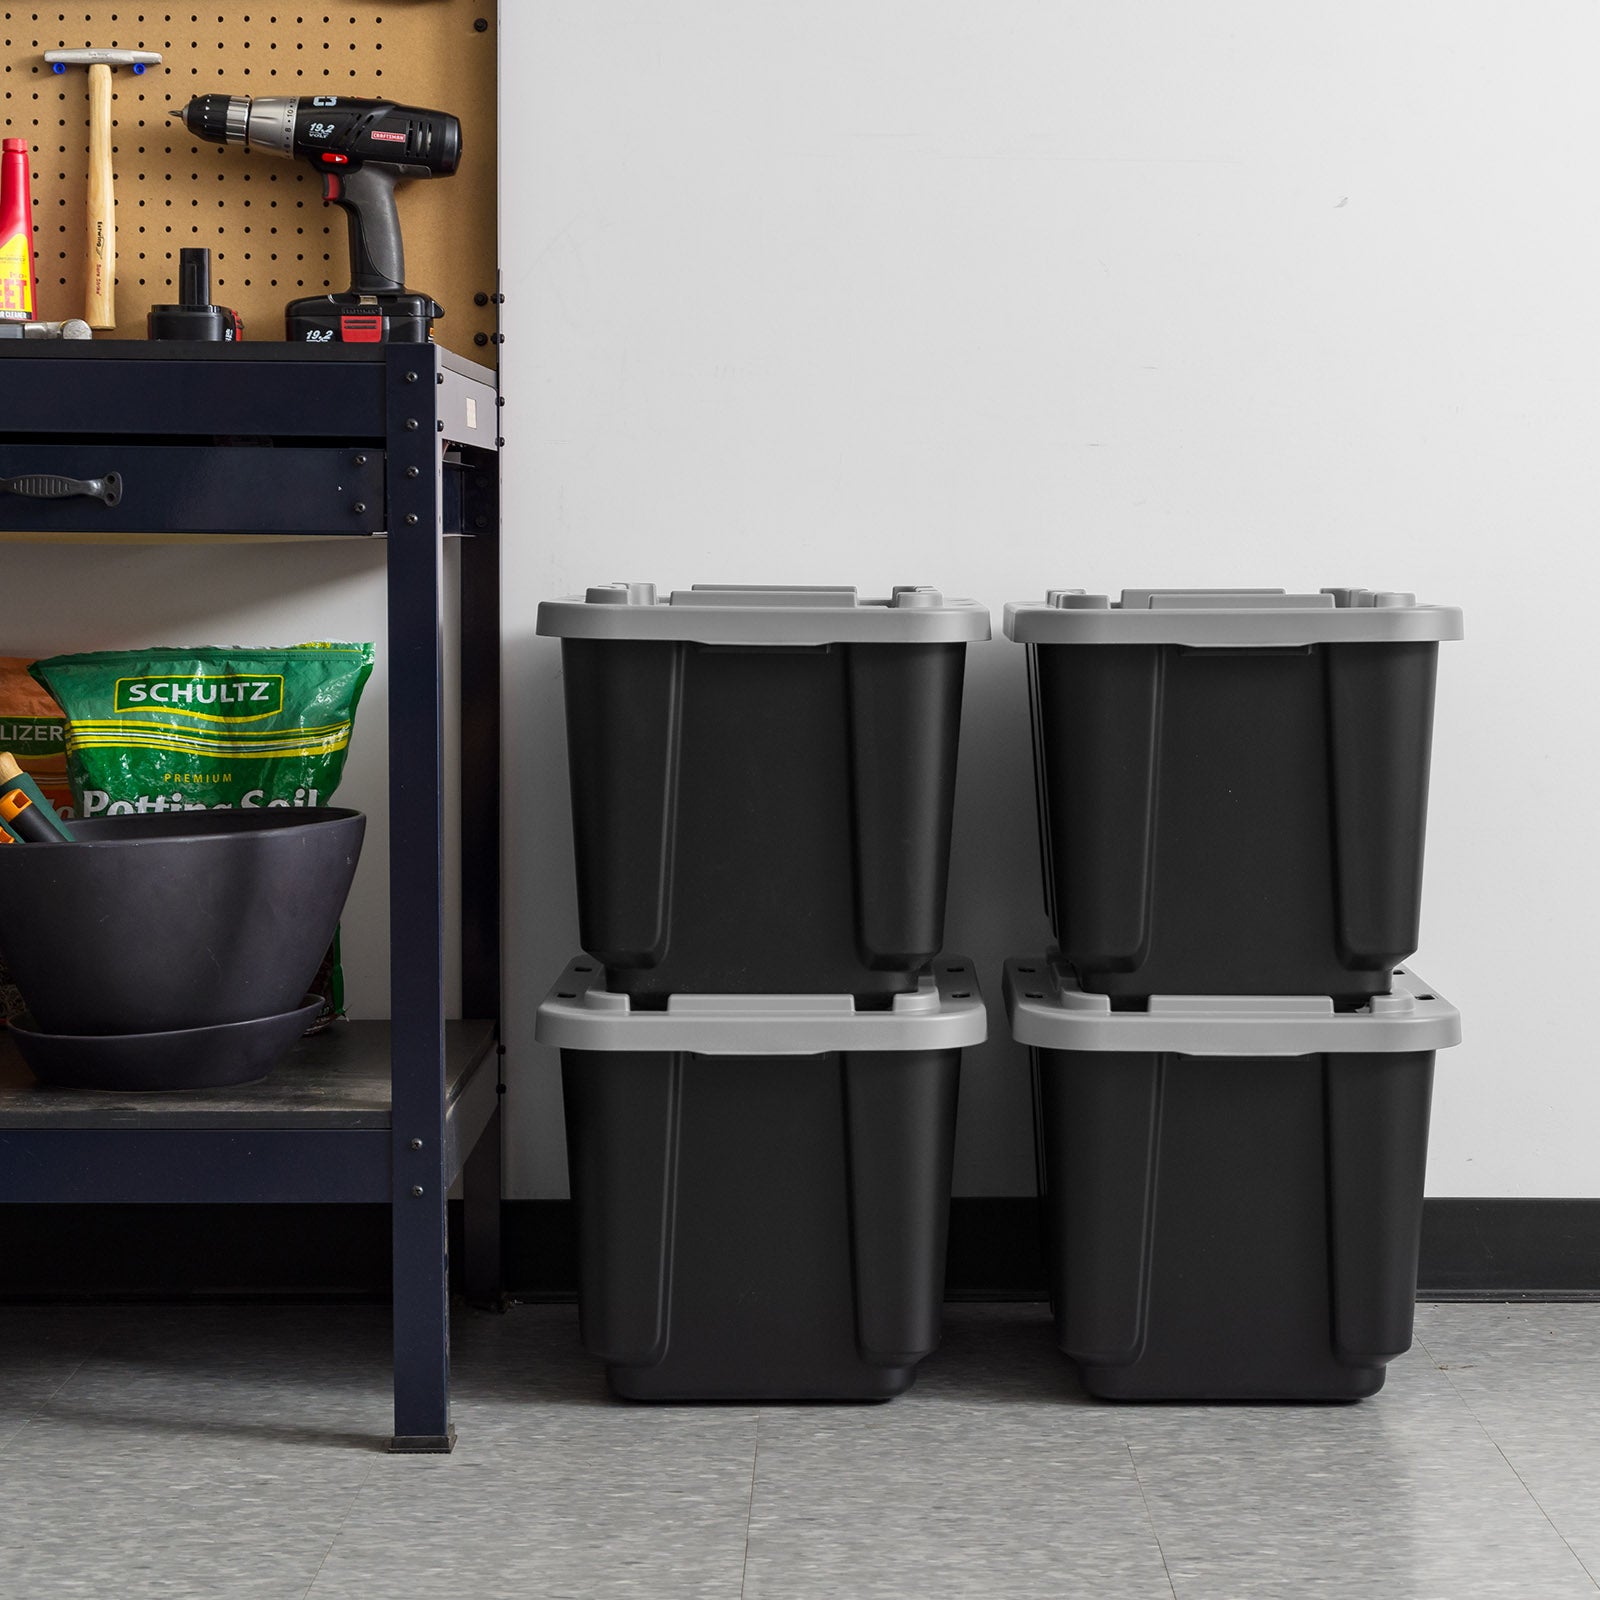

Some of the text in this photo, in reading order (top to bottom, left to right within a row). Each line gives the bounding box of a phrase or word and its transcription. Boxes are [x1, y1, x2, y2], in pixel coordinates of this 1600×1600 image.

[286, 109, 294, 117] 10
[309, 122, 335, 134] 19.2
[372, 132, 405, 141] CRAFTSMAN
[306, 330, 334, 341] 19.2
[129, 682, 271, 704] SCHULTZ
[0, 725, 63, 741] LIZER
[164, 773, 233, 783] PREMIUM
[83, 790, 232, 818] Potti
